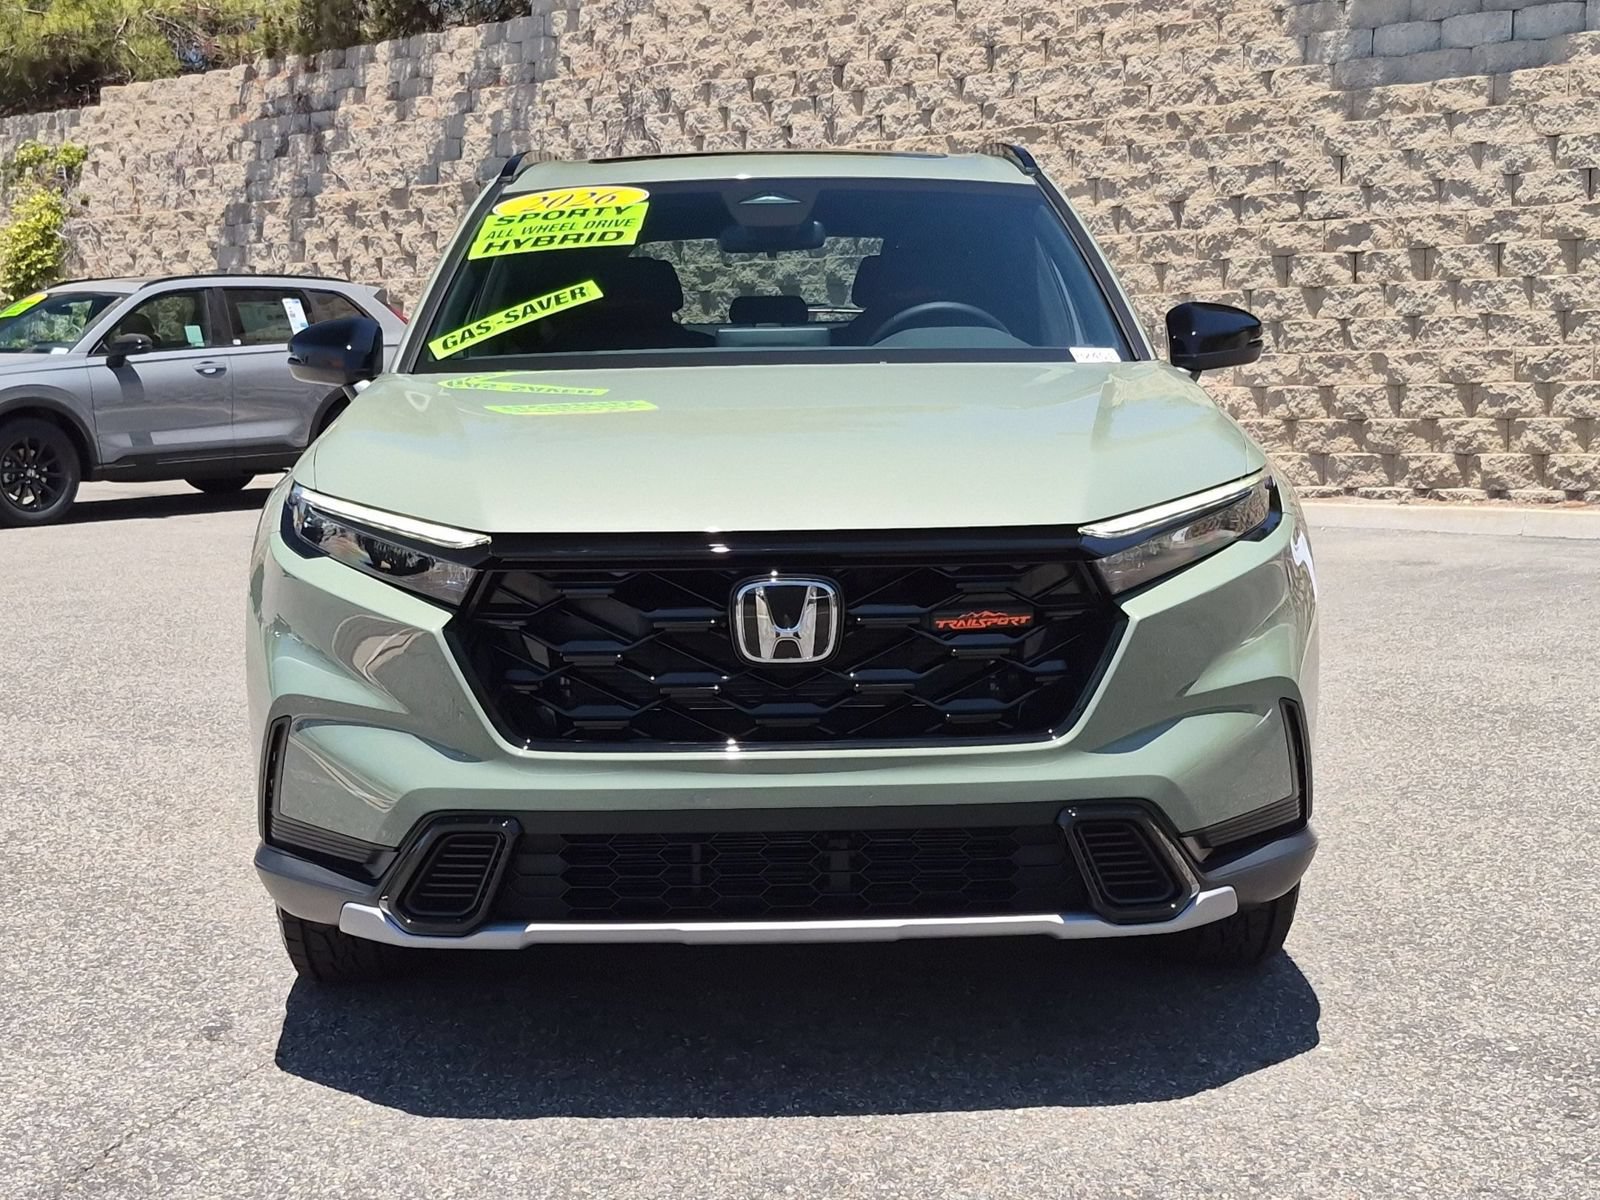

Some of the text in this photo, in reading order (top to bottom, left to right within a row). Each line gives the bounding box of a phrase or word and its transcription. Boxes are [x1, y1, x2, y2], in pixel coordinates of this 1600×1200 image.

[523, 190, 621, 212] 2026
[494, 205, 633, 226] SPORTY
[485, 218, 637, 240] ALL WHEEL DRIVE
[482, 230, 625, 254] HYBRID
[442, 285, 588, 351] GAS-SAVER
[935, 615, 1031, 630] TRAILSPORT
